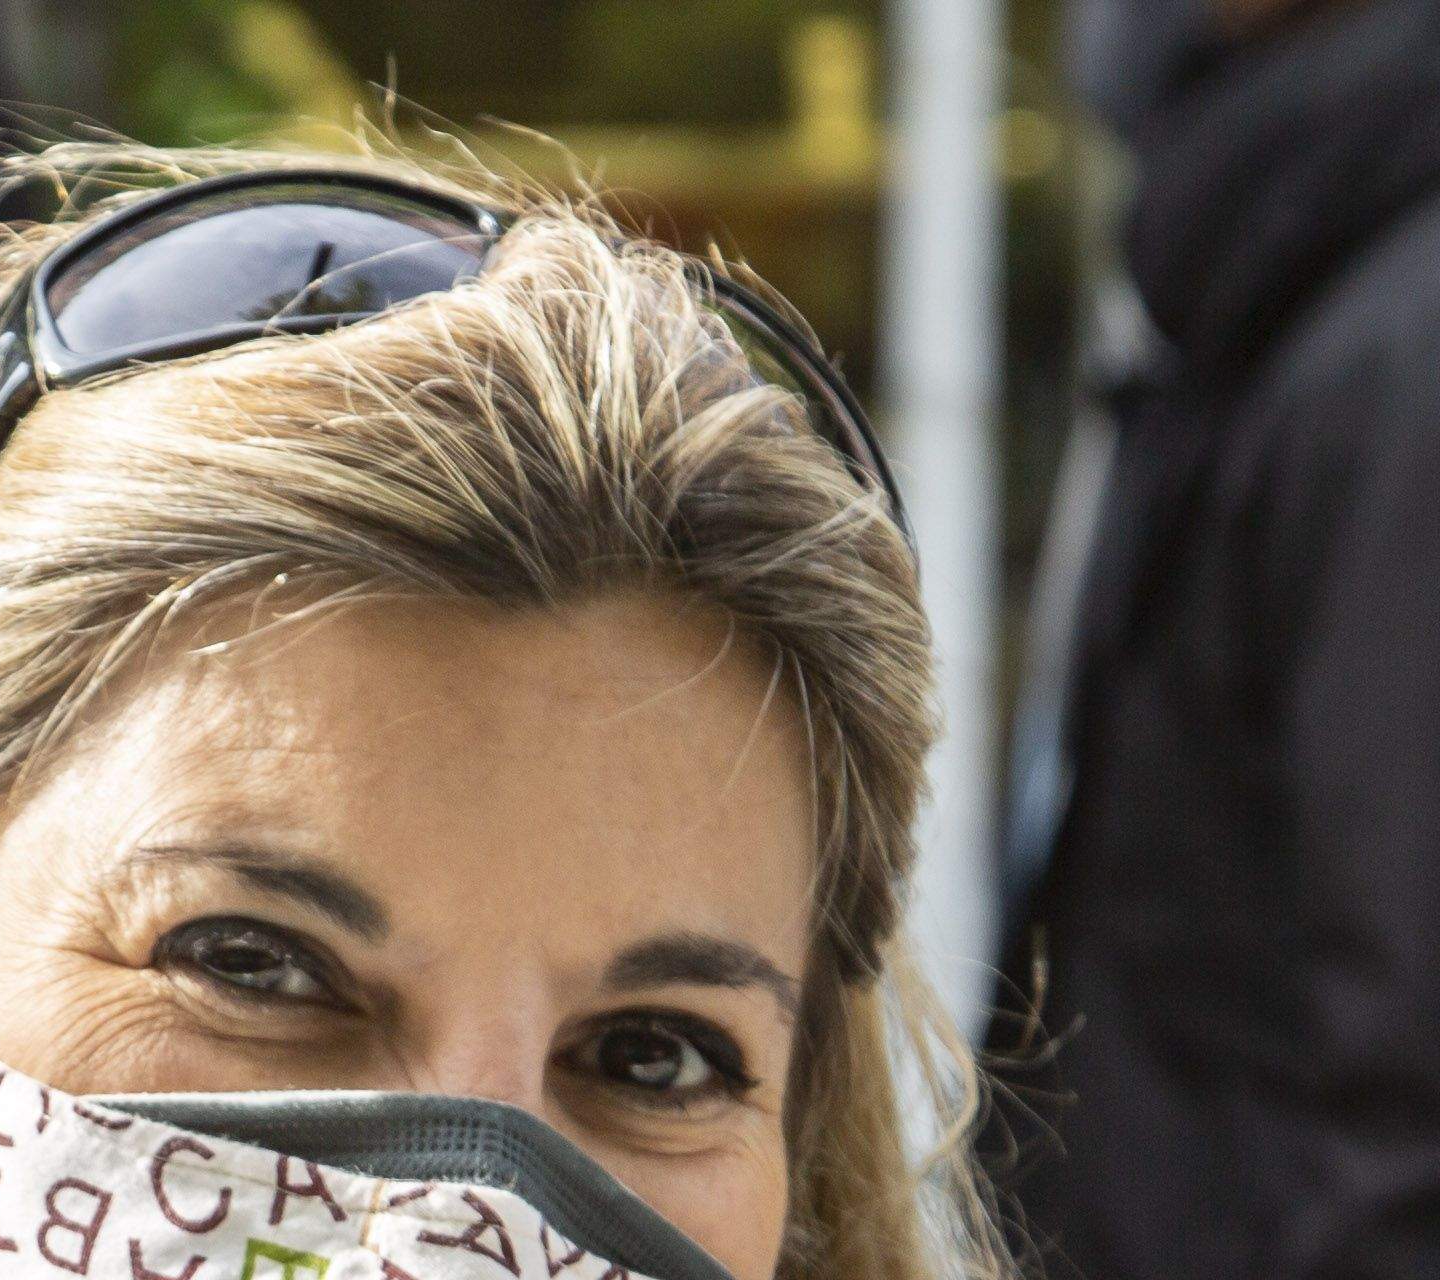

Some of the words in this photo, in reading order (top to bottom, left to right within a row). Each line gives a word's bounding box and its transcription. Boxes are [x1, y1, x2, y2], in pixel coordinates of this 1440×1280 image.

[37, 1177, 114, 1277] B
[150, 1136, 233, 1235] C
[418, 1190, 523, 1279] A
